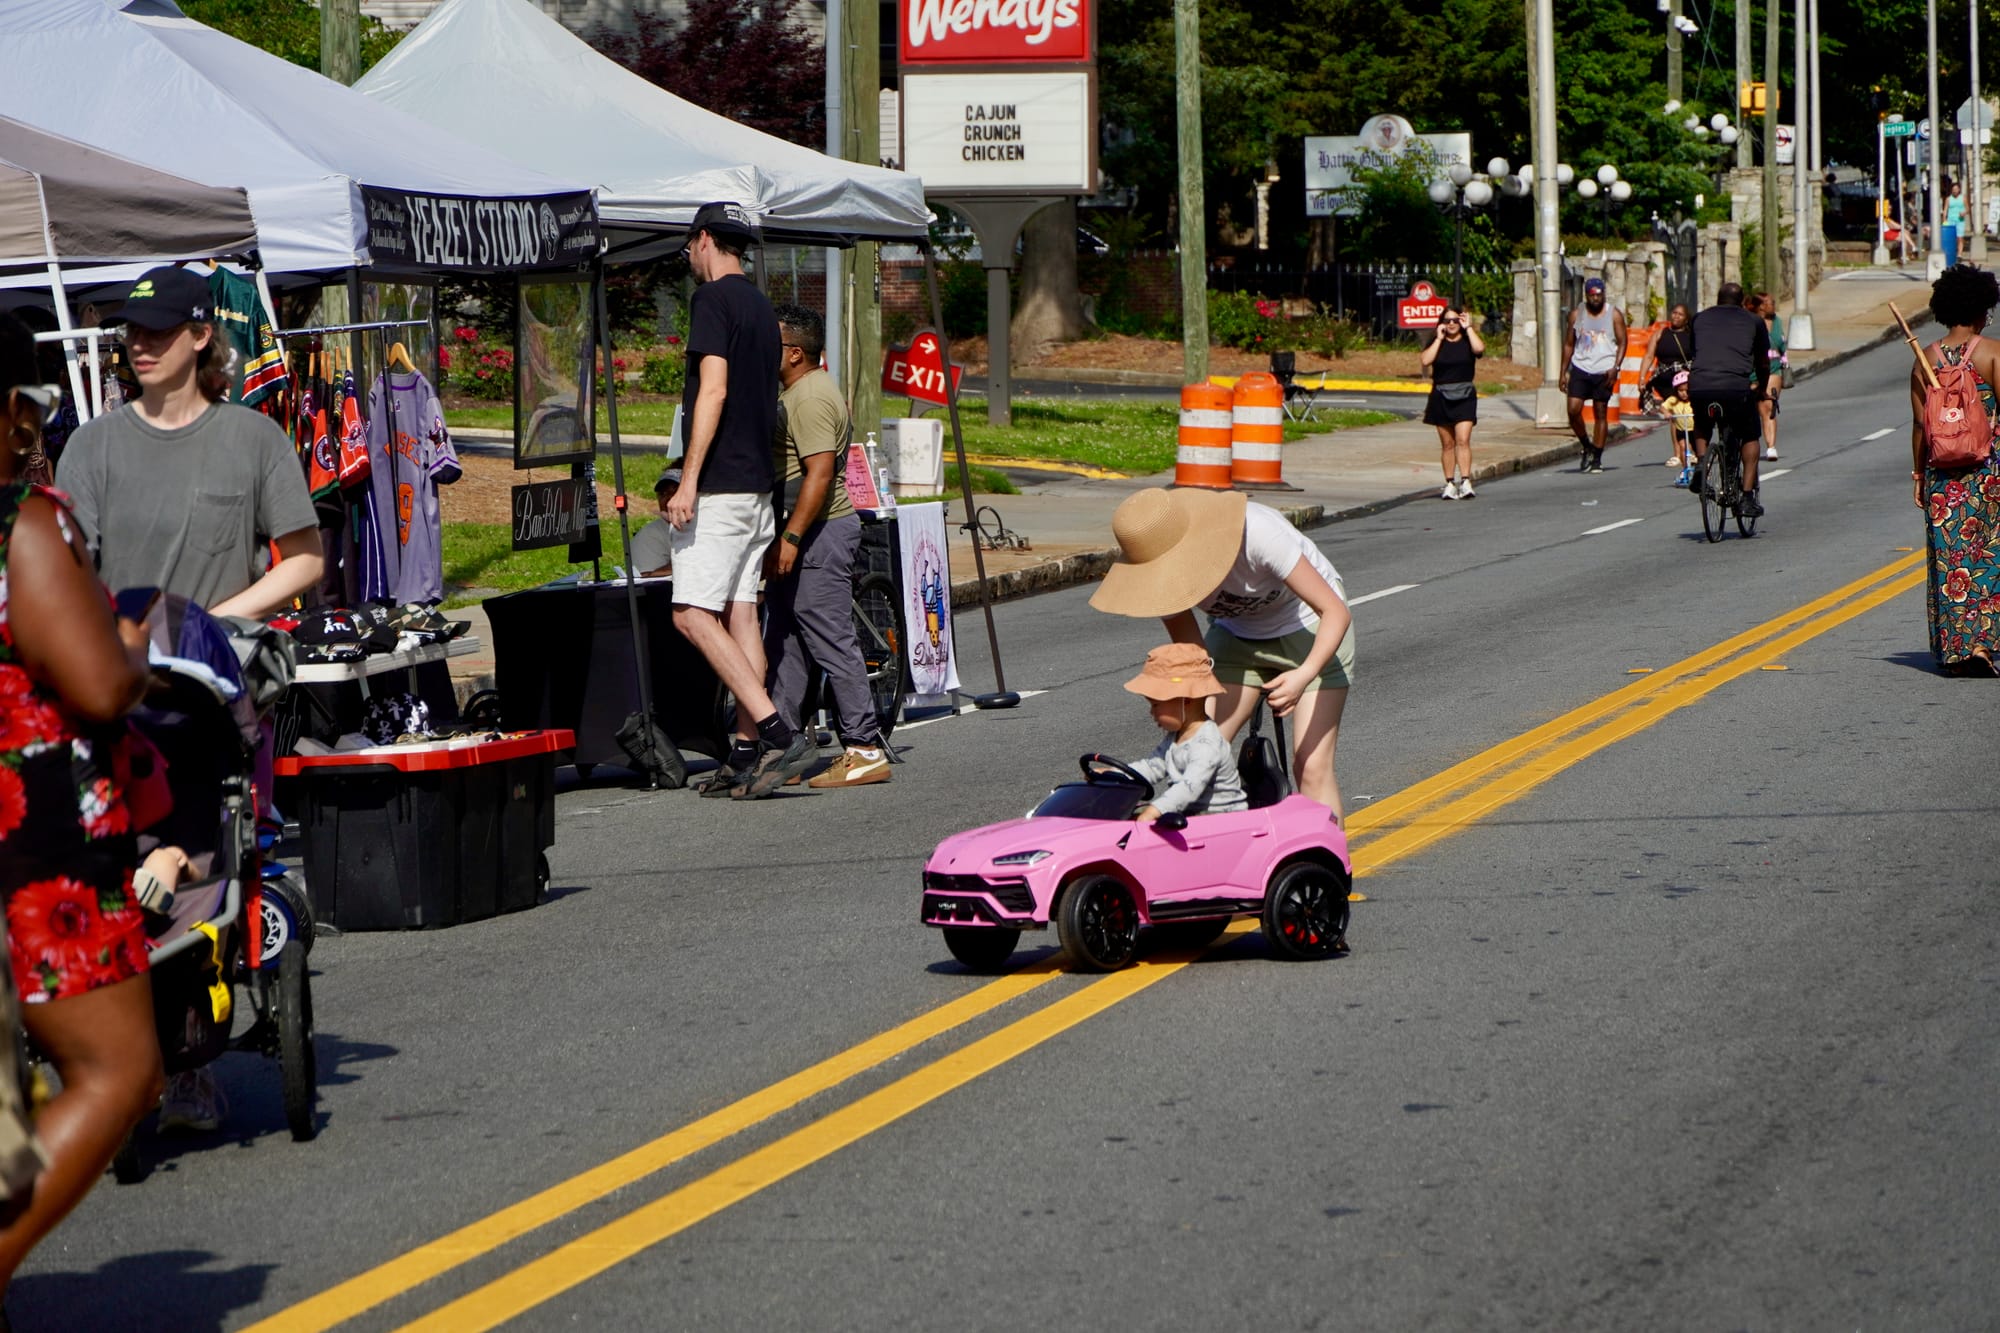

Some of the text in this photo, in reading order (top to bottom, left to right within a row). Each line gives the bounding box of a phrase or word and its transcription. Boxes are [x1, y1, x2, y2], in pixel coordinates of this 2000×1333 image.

[965, 104, 1017, 122] CAJUN
[964, 124, 1021, 142] CRUNCH
[962, 144, 1025, 162] CHICKEN
[405, 196, 541, 267] VEAZEY STUDIO
[890, 360, 946, 394] EXIT
[323, 622, 351, 634] ATL
